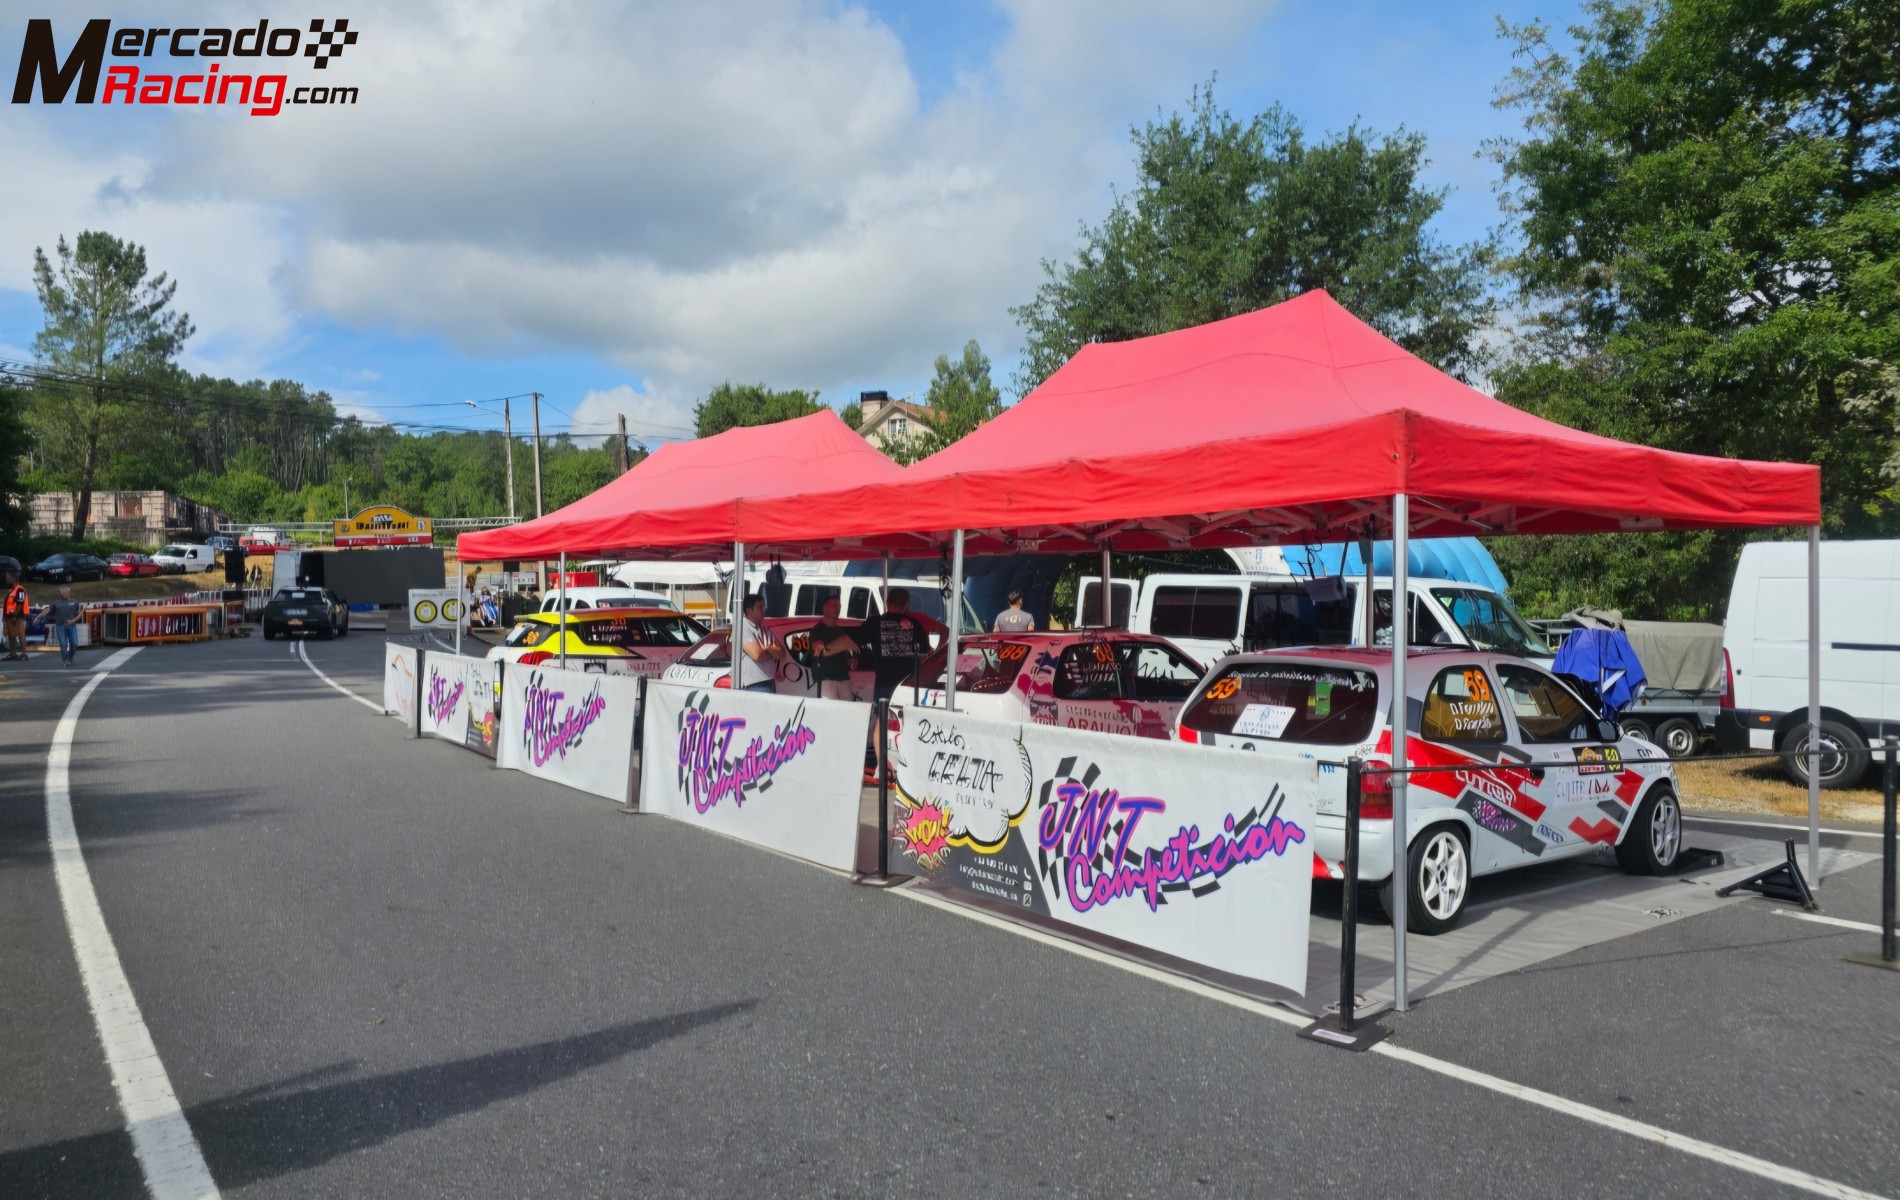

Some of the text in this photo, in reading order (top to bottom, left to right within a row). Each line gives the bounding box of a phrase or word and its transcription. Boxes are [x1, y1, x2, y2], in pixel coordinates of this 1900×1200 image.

[1206, 677, 1242, 699] 59
[1463, 669, 1491, 702] 59
[679, 711, 746, 778] JNT
[1039, 784, 1166, 870] JNT
